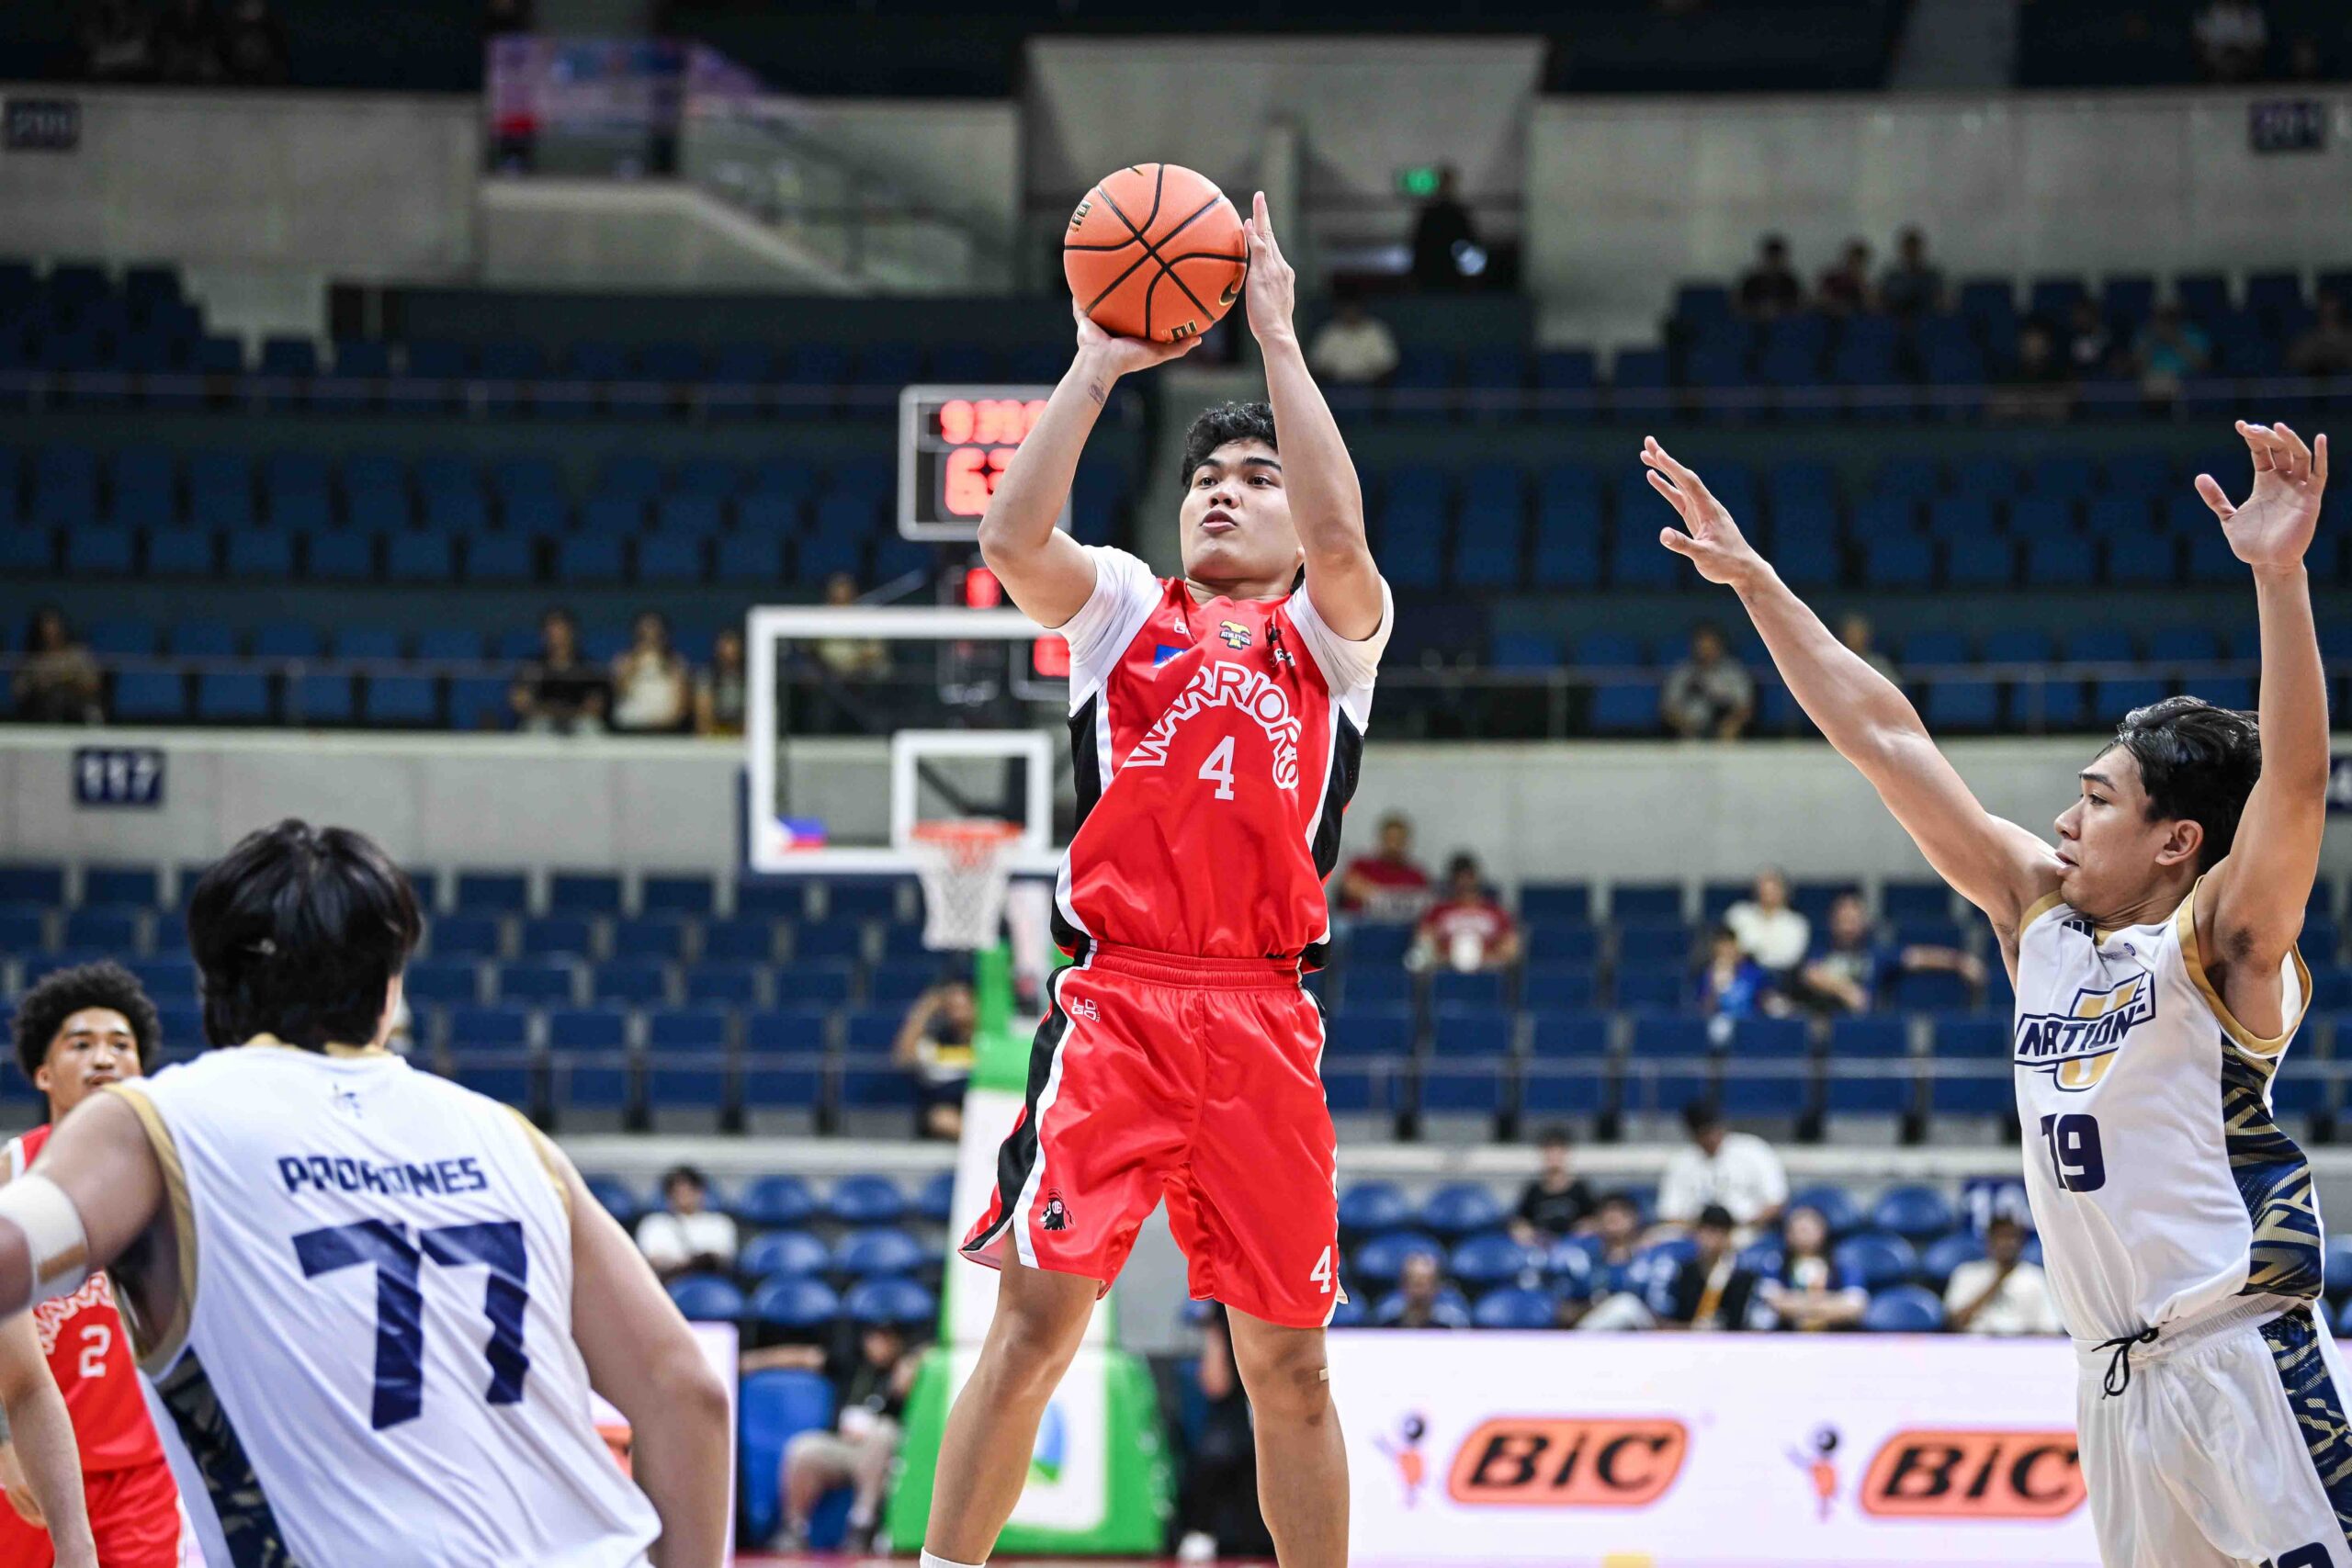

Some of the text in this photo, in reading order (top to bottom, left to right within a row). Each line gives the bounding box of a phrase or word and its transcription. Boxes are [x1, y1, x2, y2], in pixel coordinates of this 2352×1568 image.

[1123, 660, 1302, 790] WARRIORS
[1198, 736, 1235, 801] 4
[2040, 1113, 2107, 1192] 19
[1309, 1245, 1332, 1294] 4
[80, 1324, 111, 1378] 2
[291, 1219, 530, 1430] 77
